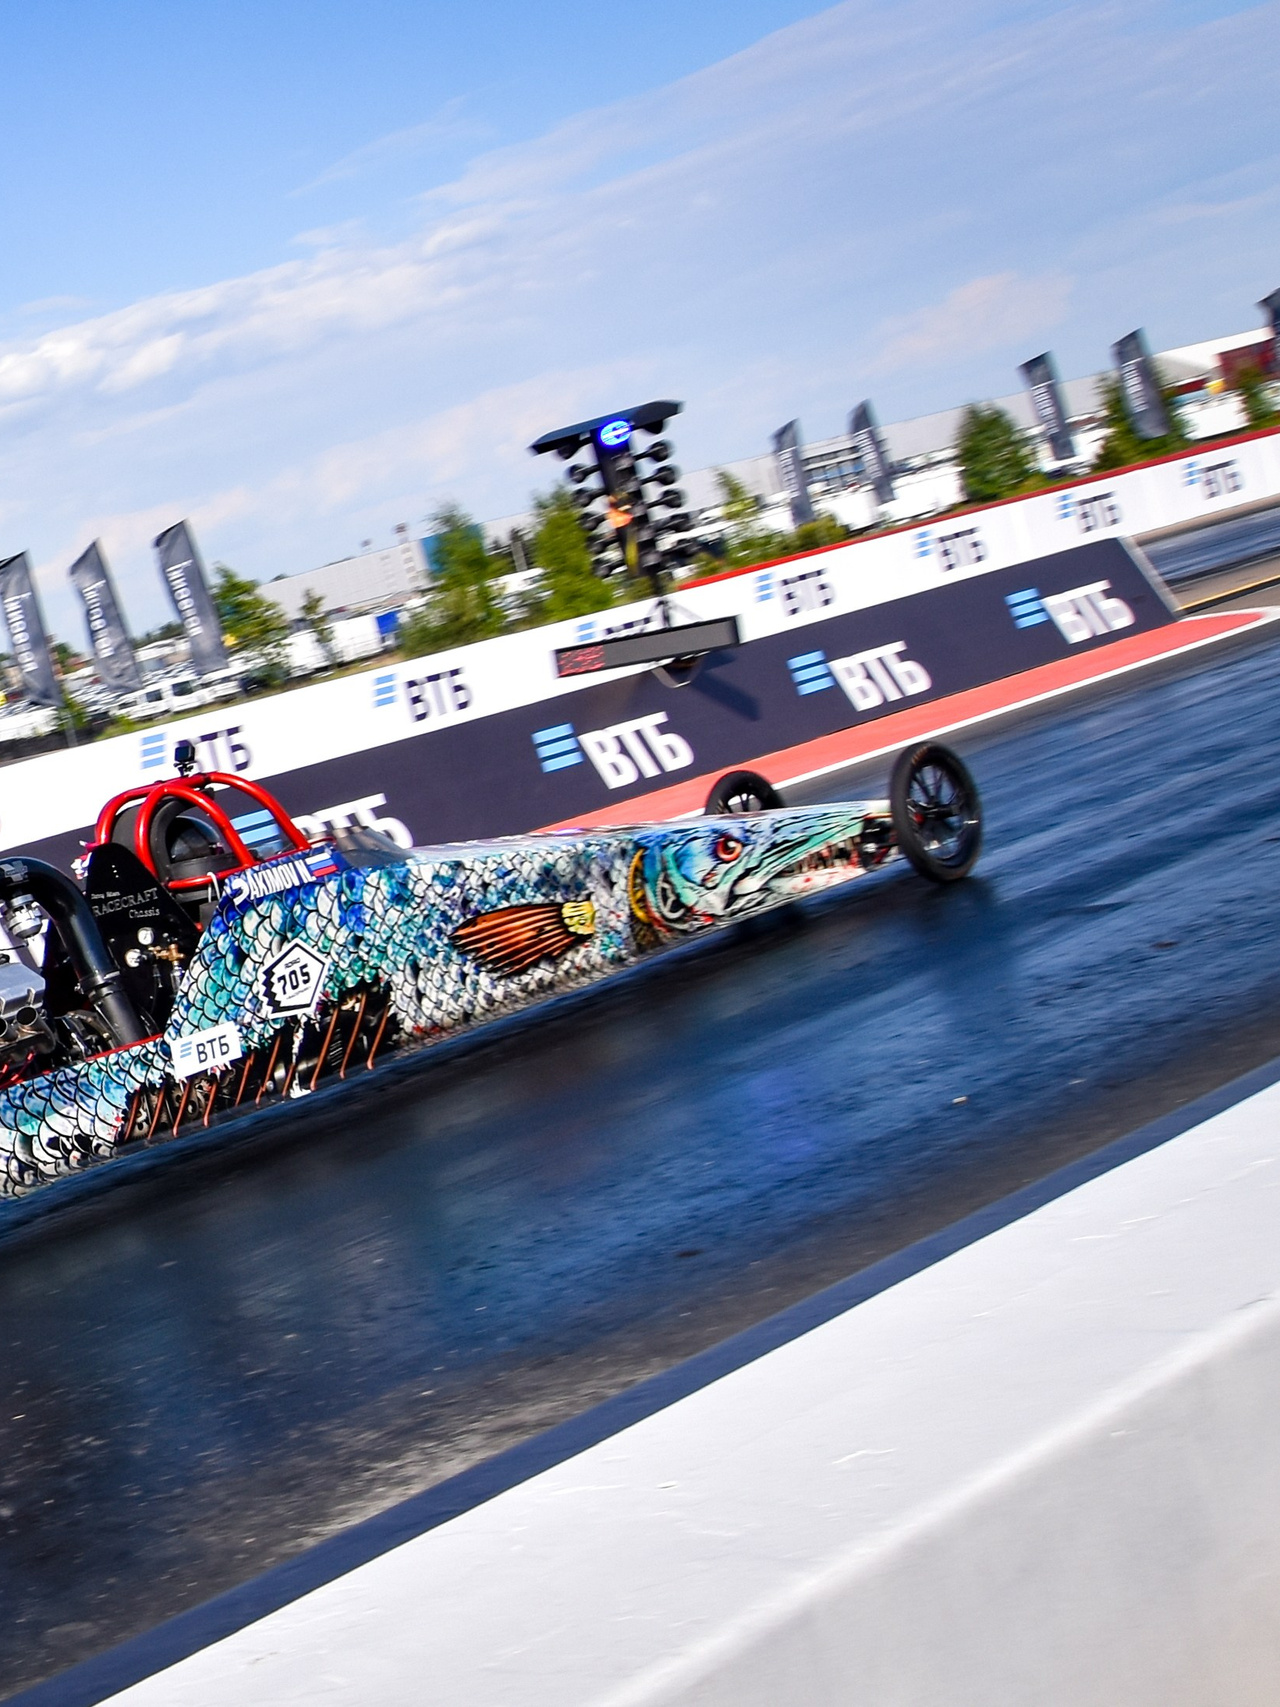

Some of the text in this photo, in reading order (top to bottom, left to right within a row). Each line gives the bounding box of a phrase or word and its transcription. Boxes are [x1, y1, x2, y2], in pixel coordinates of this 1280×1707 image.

[1075, 491, 1122, 533] ВТБ
[938, 526, 988, 572] ВТБ
[779, 567, 837, 617] ВТБ
[1040, 579, 1135, 645] ВТБ
[405, 667, 474, 723] ВТБ
[828, 640, 933, 712] ВТБ
[578, 711, 695, 790] ВТБ
[91, 887, 159, 917] RACECRAFT
[249, 862, 300, 900] AKIMOV
[128, 906, 161, 919] Chassis
[277, 963, 311, 995] 705
[196, 1034, 230, 1064] ВТБ
